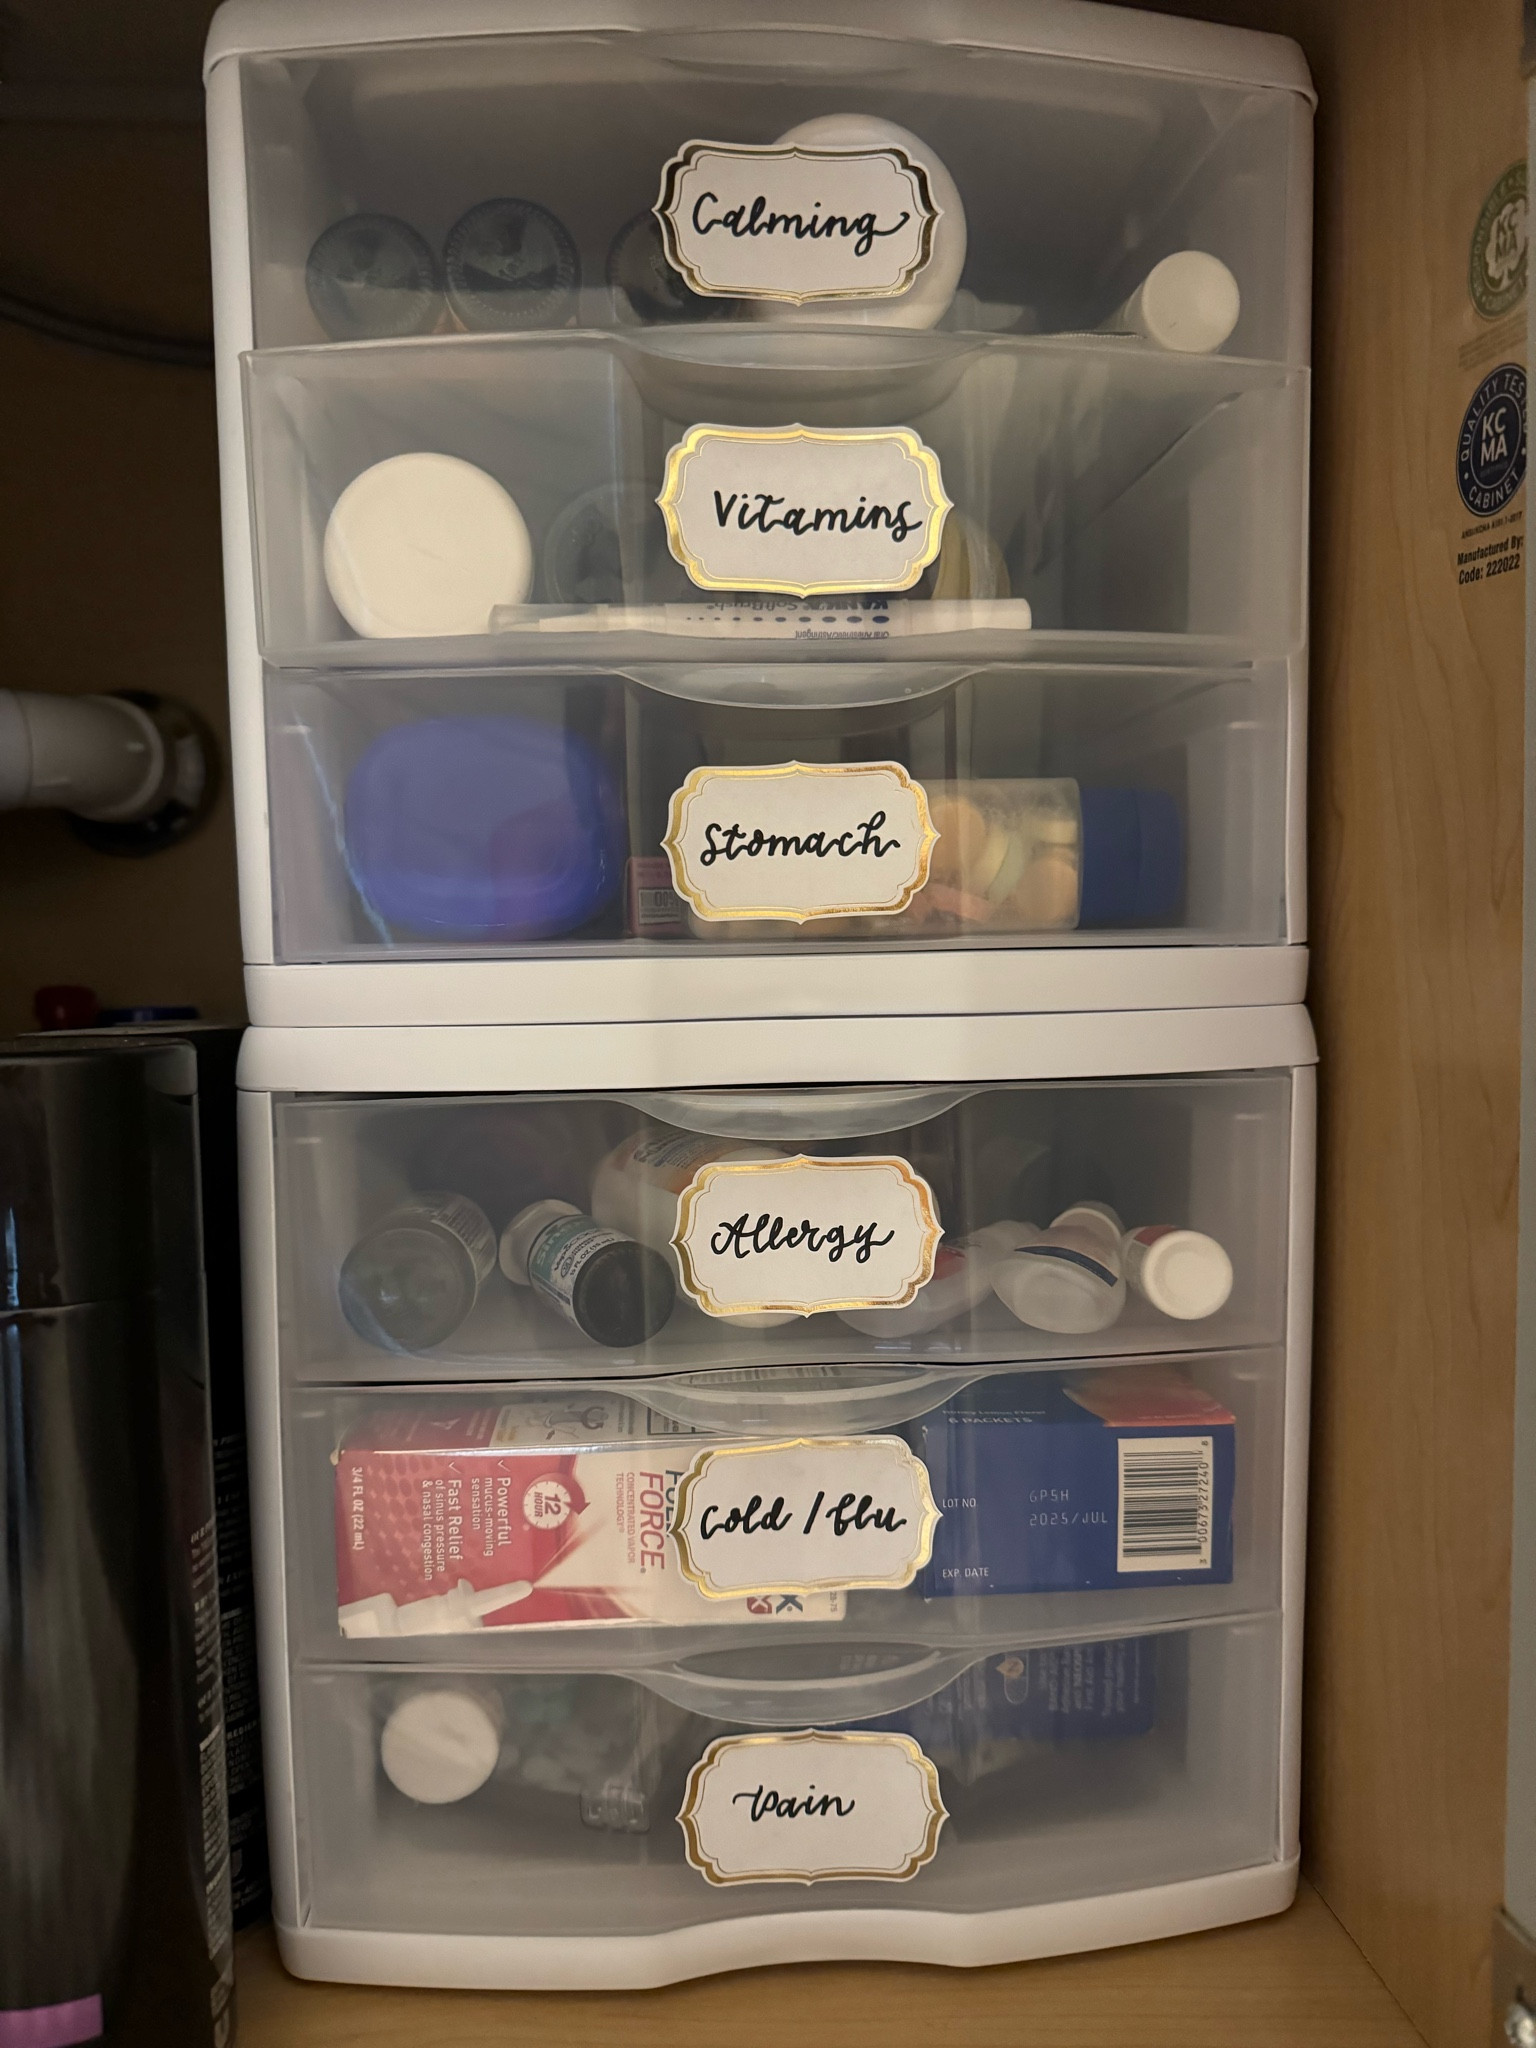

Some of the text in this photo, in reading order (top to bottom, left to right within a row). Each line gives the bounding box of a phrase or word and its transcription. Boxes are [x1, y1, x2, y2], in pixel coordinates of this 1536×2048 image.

[692, 191, 910, 256] Calming
[1461, 378, 1498, 462] QUALITY
[1482, 407, 1507, 441] KC
[1480, 434, 1508, 467] MA
[1469, 467, 1519, 509] CABINET
[713, 489, 923, 542] Vitamins
[1457, 535, 1524, 565] Manufactured By:
[1459, 553, 1520, 585] Code: 222022
[700, 810, 901, 867] Stomach
[710, 1212, 895, 1264] Allergy
[352, 1466, 365, 1551] 3/4 FL OZ (22 mL)
[434, 1479, 446, 1572] of sinus pressure
[448, 1480, 463, 1560] Fast Relief
[471, 1478, 482, 1530] sensation
[483, 1477, 496, 1557] mucus-moving
[497, 1477, 512, 1546] Powerful
[534, 1491, 543, 1518] HOUR
[544, 1493, 562, 1516] 12
[627, 1471, 636, 1564] CONCENTRATED VAPOR
[942, 1496, 977, 1509] LOT NO
[421, 1480, 434, 1581] & nasal congestion
[964, 1566, 990, 1578] DATE
[731, 1784, 855, 1822] Pain
